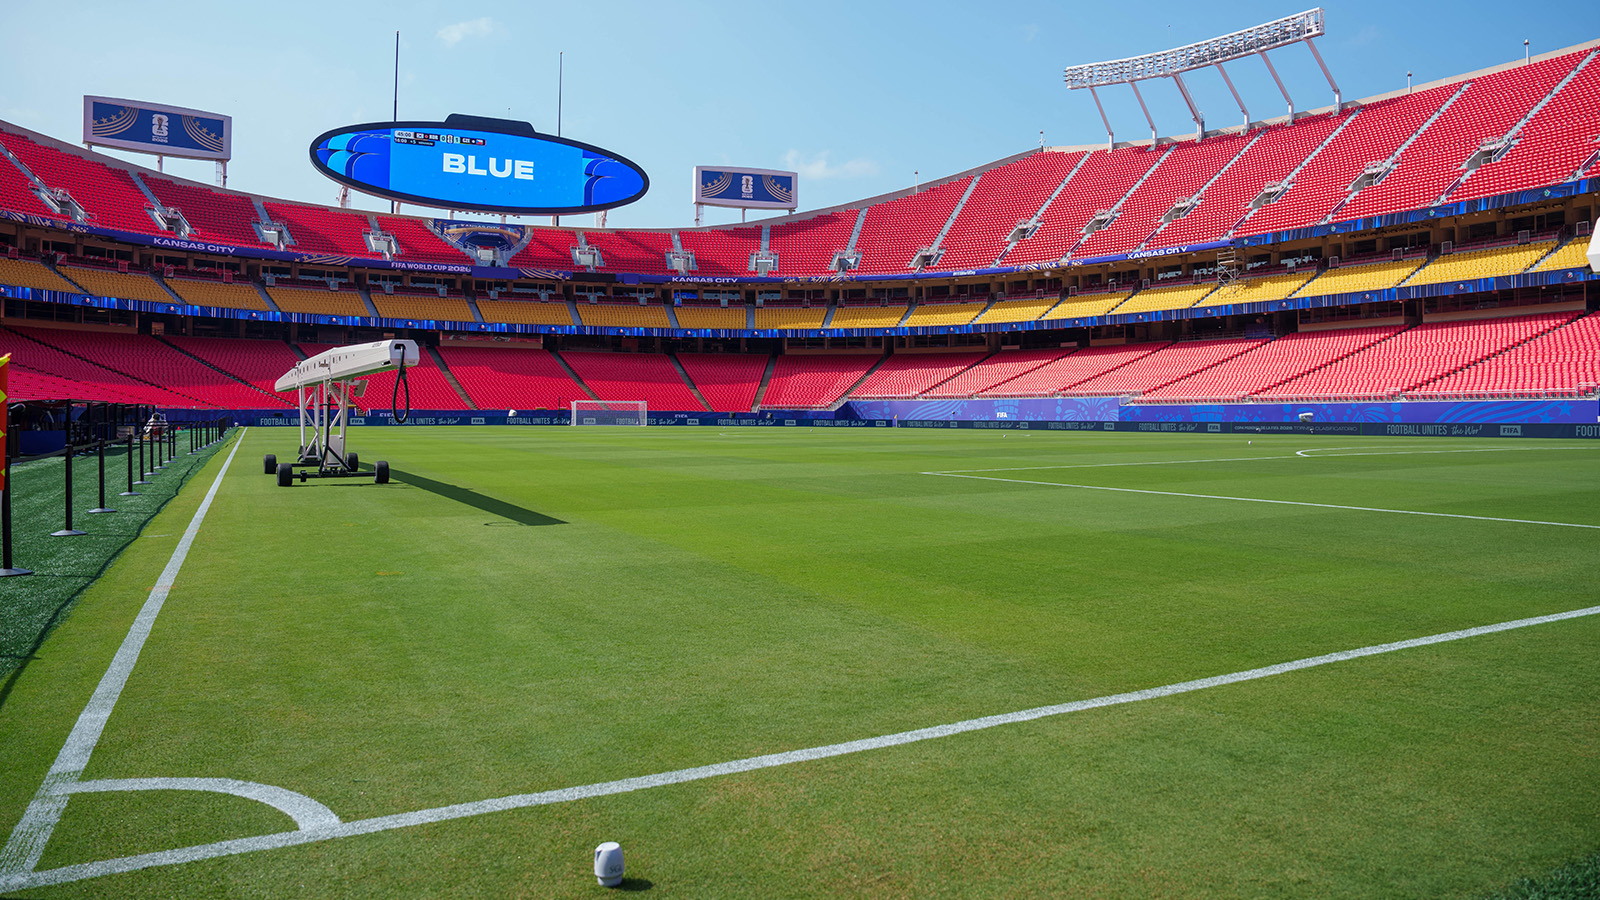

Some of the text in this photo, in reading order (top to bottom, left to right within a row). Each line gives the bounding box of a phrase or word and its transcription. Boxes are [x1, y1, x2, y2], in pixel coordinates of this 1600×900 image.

[443, 152, 534, 180] BLUE
[154, 238, 235, 254] KANSAS CITY
[1128, 249, 1164, 260] KANSAS
[1138, 423, 1160, 431] FOOTBALL
[1161, 423, 1176, 431] UNITES
[1387, 424, 1420, 434] FOOTBALL
[1422, 424, 1448, 434] UNITES
[1450, 425, 1464, 434] the
